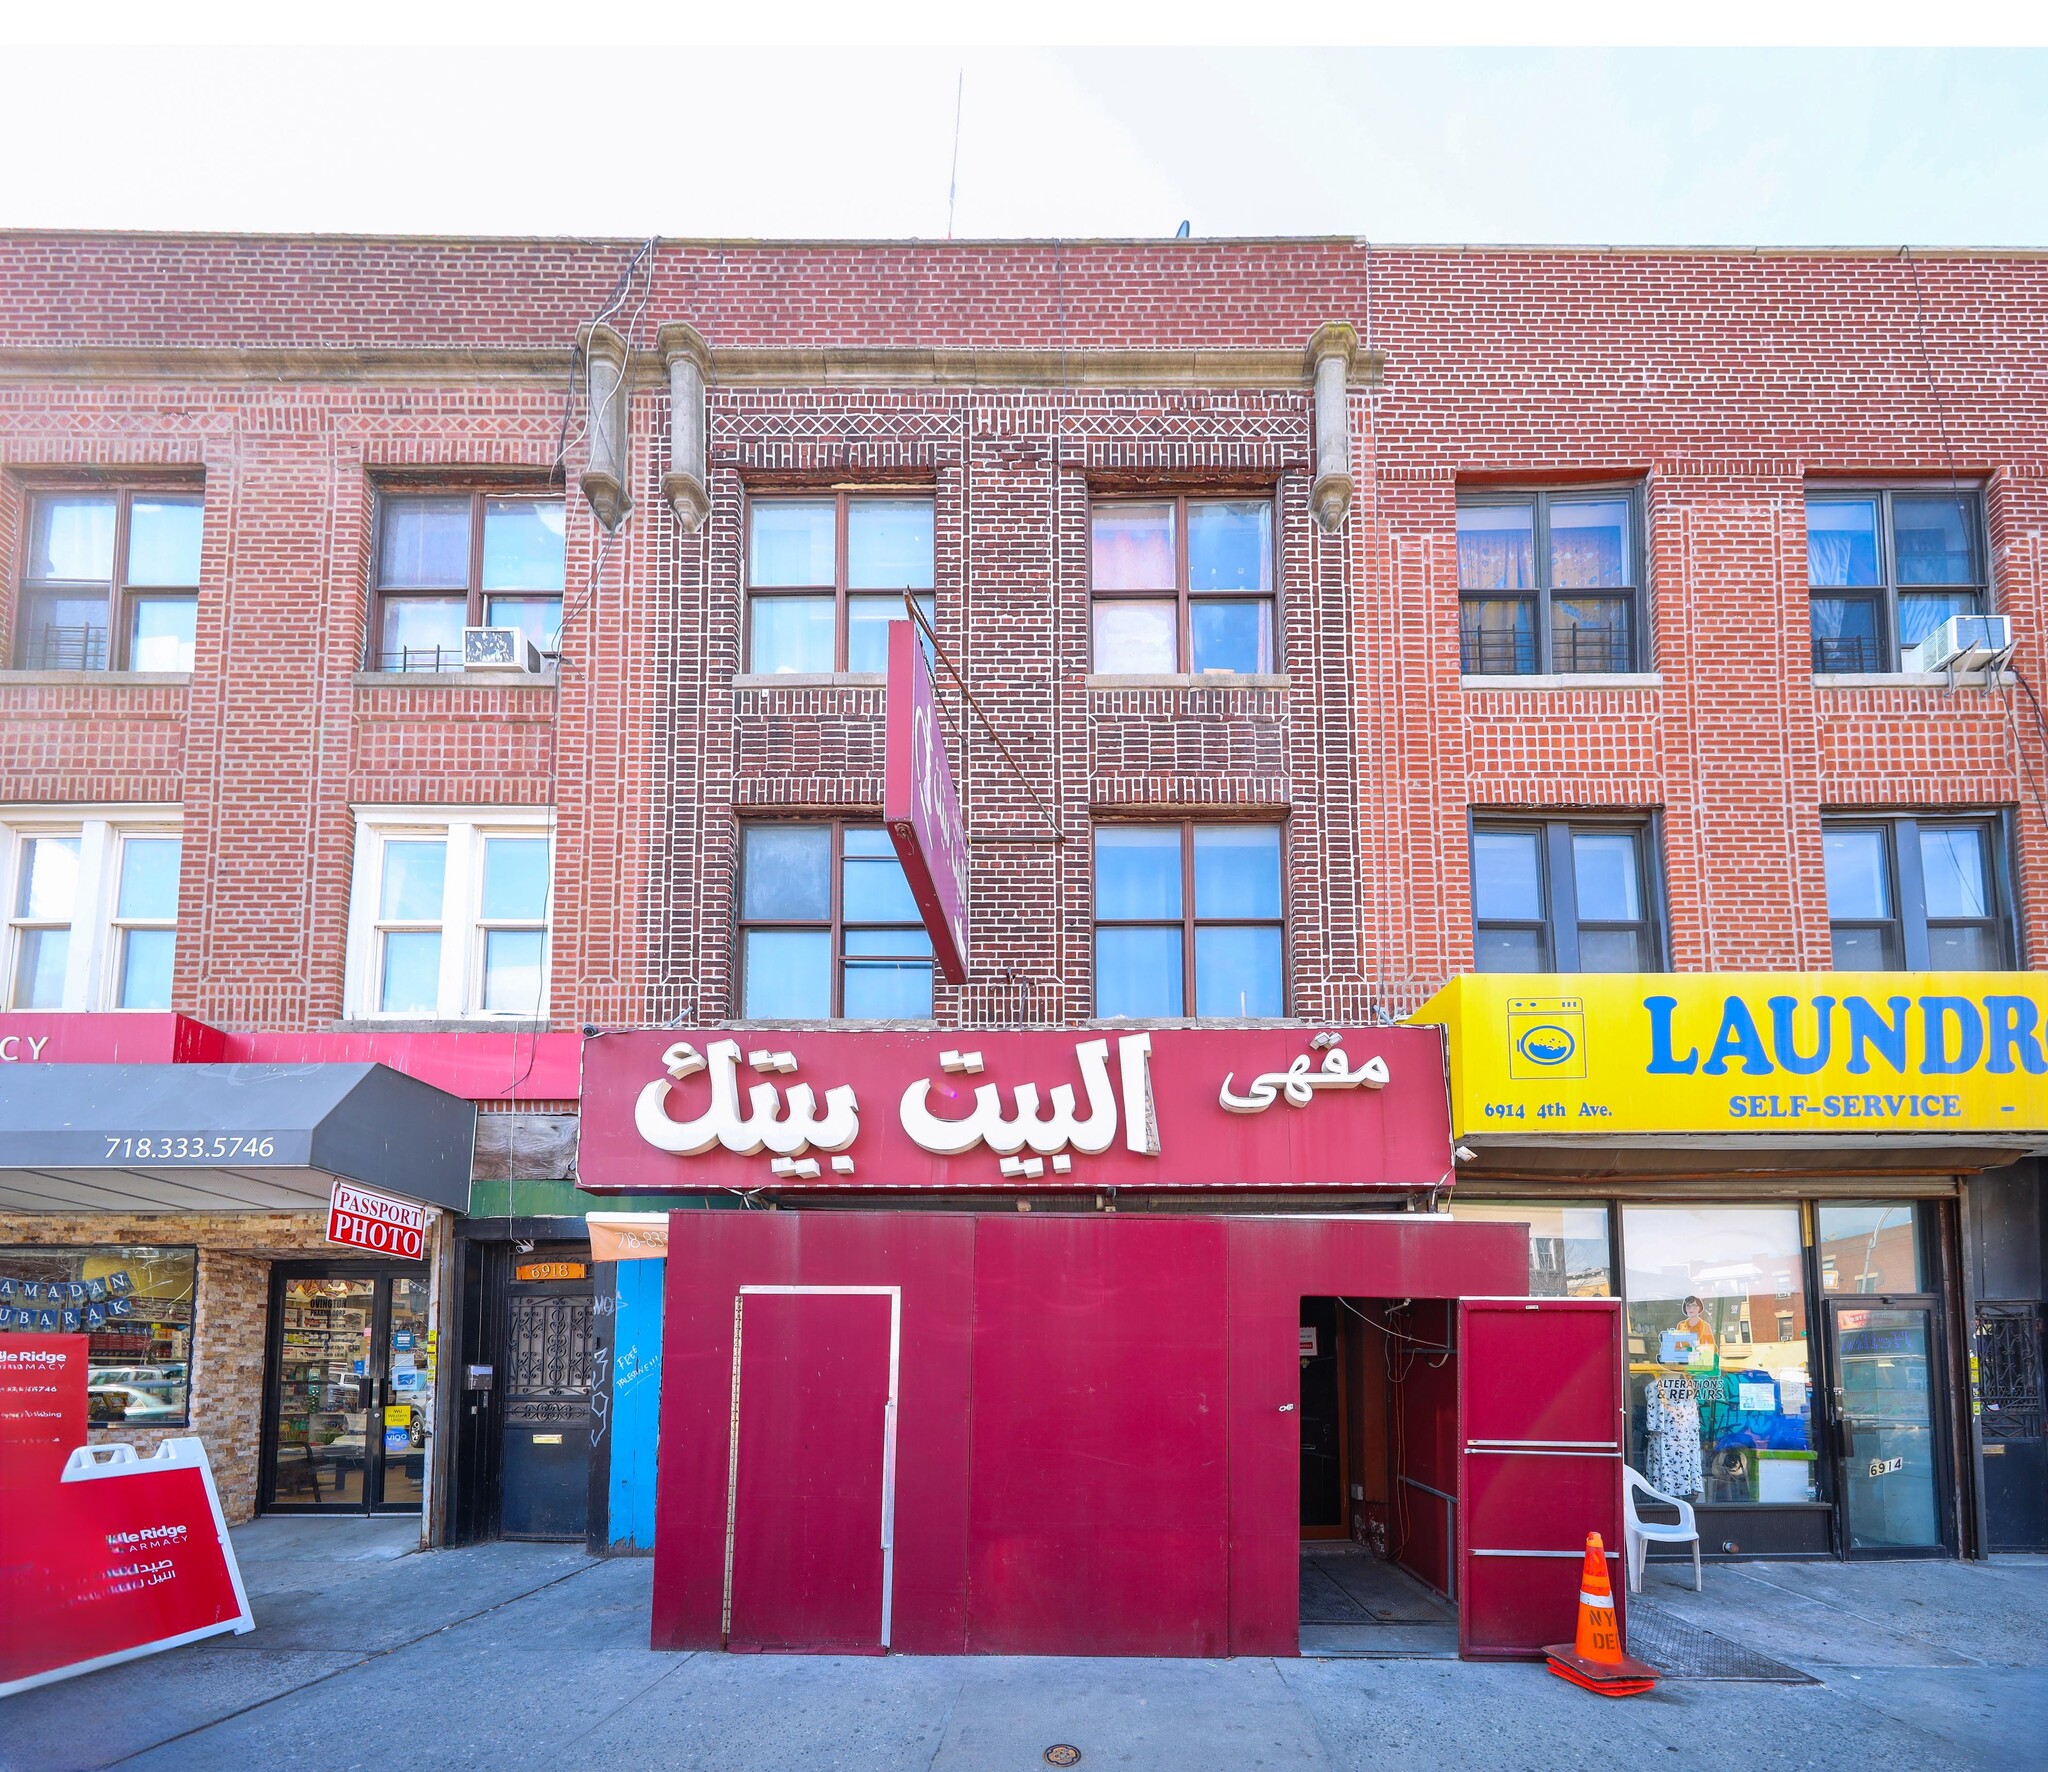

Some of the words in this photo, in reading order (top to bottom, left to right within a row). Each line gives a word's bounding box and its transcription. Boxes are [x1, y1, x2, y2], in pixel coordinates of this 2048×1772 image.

[1643, 995, 2048, 1075] LAUNDR
[634, 1039, 860, 1180] بيتك
[899, 1032, 1160, 1178] البيت
[1484, 1102, 1525, 1119] 6914
[1536, 1102, 1567, 1118] 4th
[1578, 1102, 1614, 1118] Ave.
[1728, 1094, 1962, 1118] SELF-SERVICE
[105, 1136, 275, 1160] 718.333.5746
[339, 1191, 421, 1228] PASSPORT
[333, 1213, 421, 1255] PHOTO
[531, 1263, 570, 1279] 6918
[310, 1298, 346, 1309] OVINGTON
[19, 1351, 67, 1364] Ridge
[616, 1344, 638, 1371] FREE
[1656, 1378, 1724, 1389] ALTERATIONS
[1657, 1390, 1666, 1400] &
[1669, 1389, 1724, 1400] REPAIRS
[386, 1433, 408, 1442] vigo
[1870, 1457, 1902, 1477] 6914
[140, 1524, 187, 1540] Ridge
